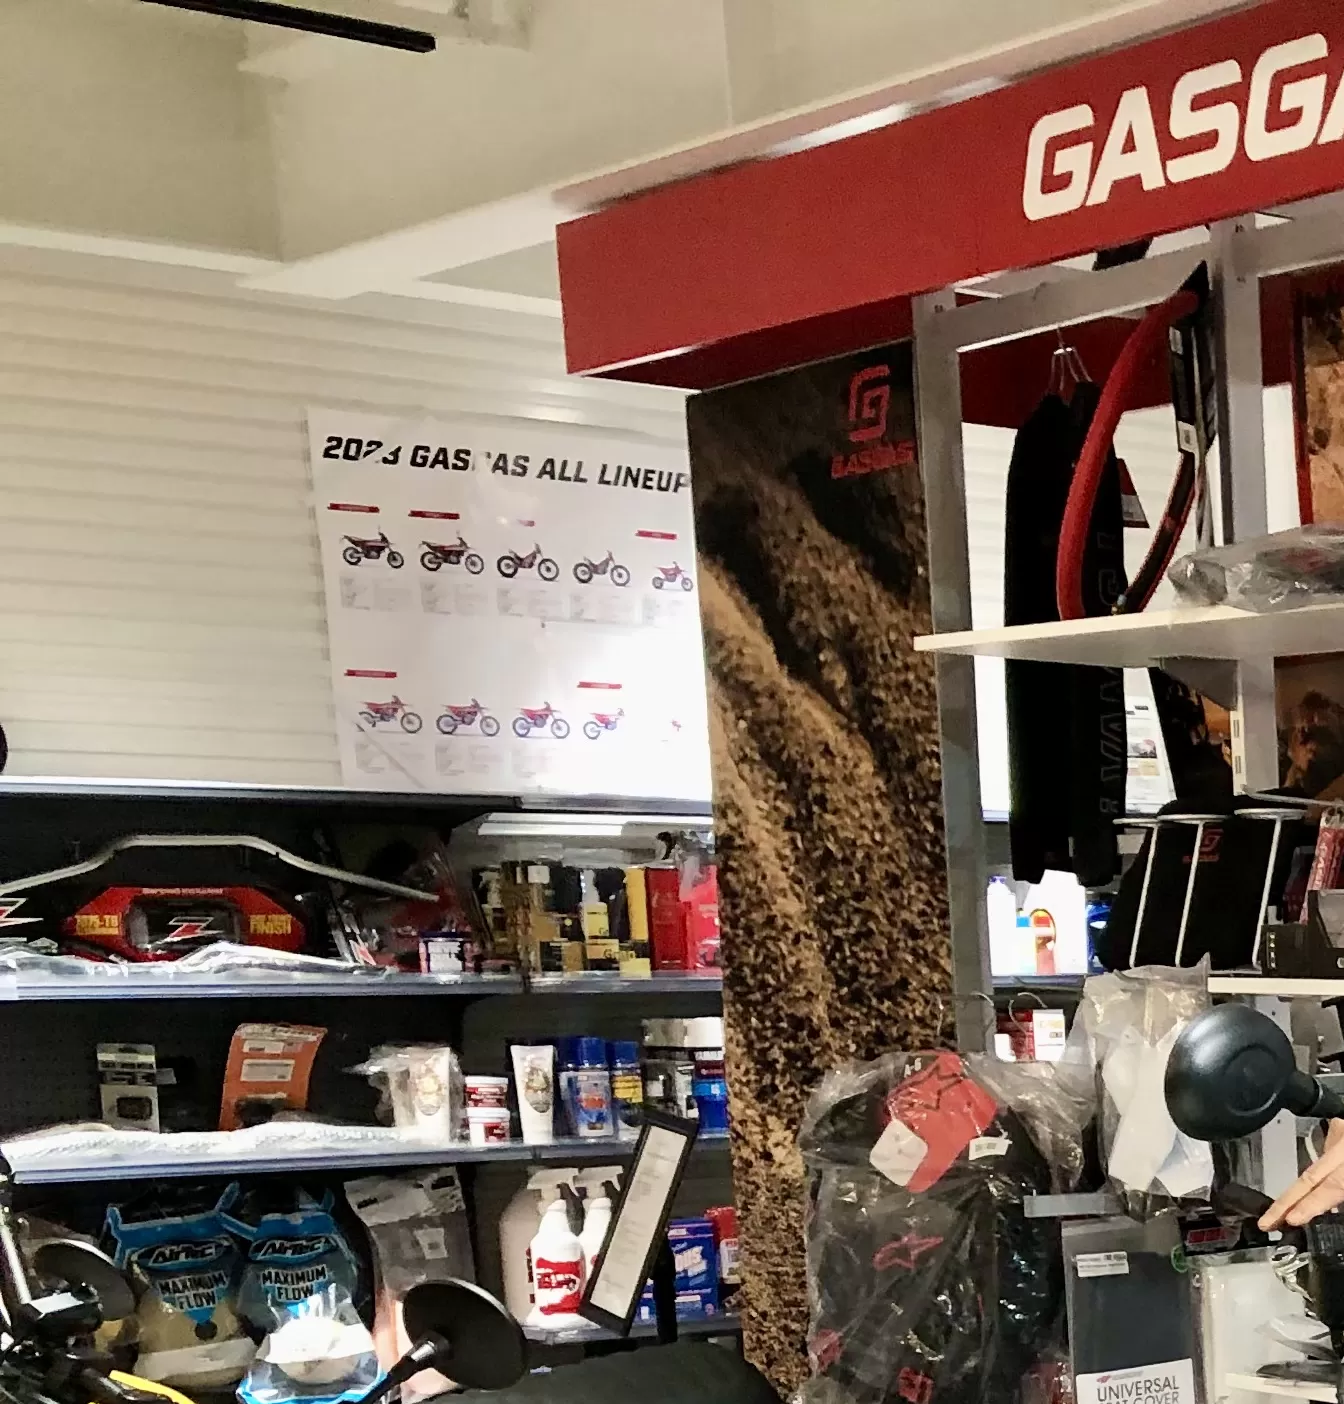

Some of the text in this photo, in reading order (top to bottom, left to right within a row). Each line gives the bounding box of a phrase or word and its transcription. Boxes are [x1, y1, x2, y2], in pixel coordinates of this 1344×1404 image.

[409, 445, 530, 478] GASAS
[536, 457, 588, 483] ALL
[596, 463, 691, 494] LINEUP
[157, 1271, 228, 1296] MAXIMUM
[262, 1265, 328, 1287] MAXIMUM
[176, 1291, 216, 1310] FLOW
[277, 1284, 314, 1302] FLOW
[1097, 1375, 1180, 1402] UNIVERSAL
